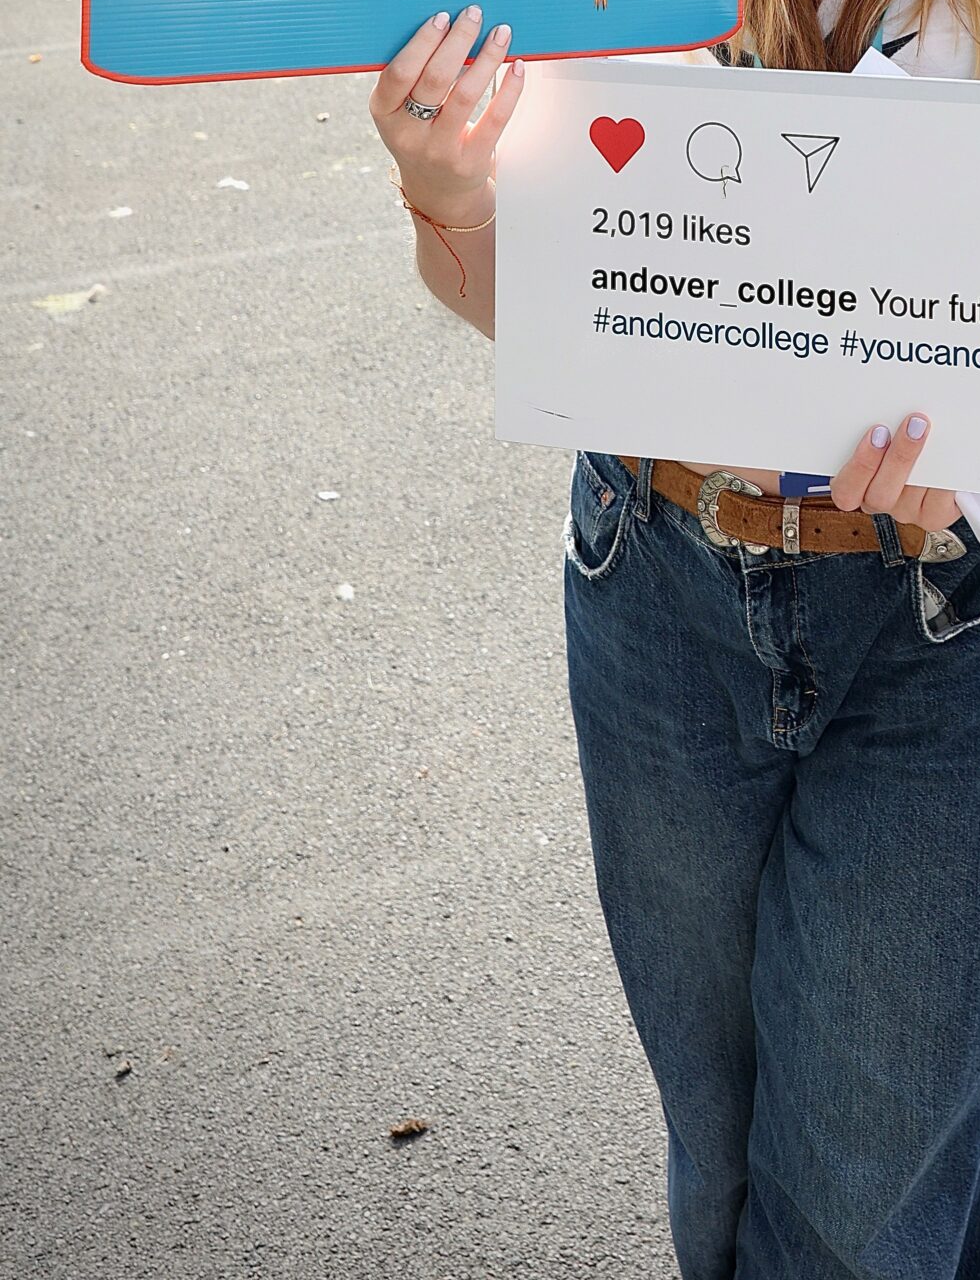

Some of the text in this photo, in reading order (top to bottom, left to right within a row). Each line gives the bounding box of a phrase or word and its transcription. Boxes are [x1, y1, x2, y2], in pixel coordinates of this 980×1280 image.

[592, 208, 751, 245] 2,019 likes
[591, 267, 857, 316] andover_college
[870, 287, 939, 320] Your
[593, 307, 829, 358] #andovercollege
